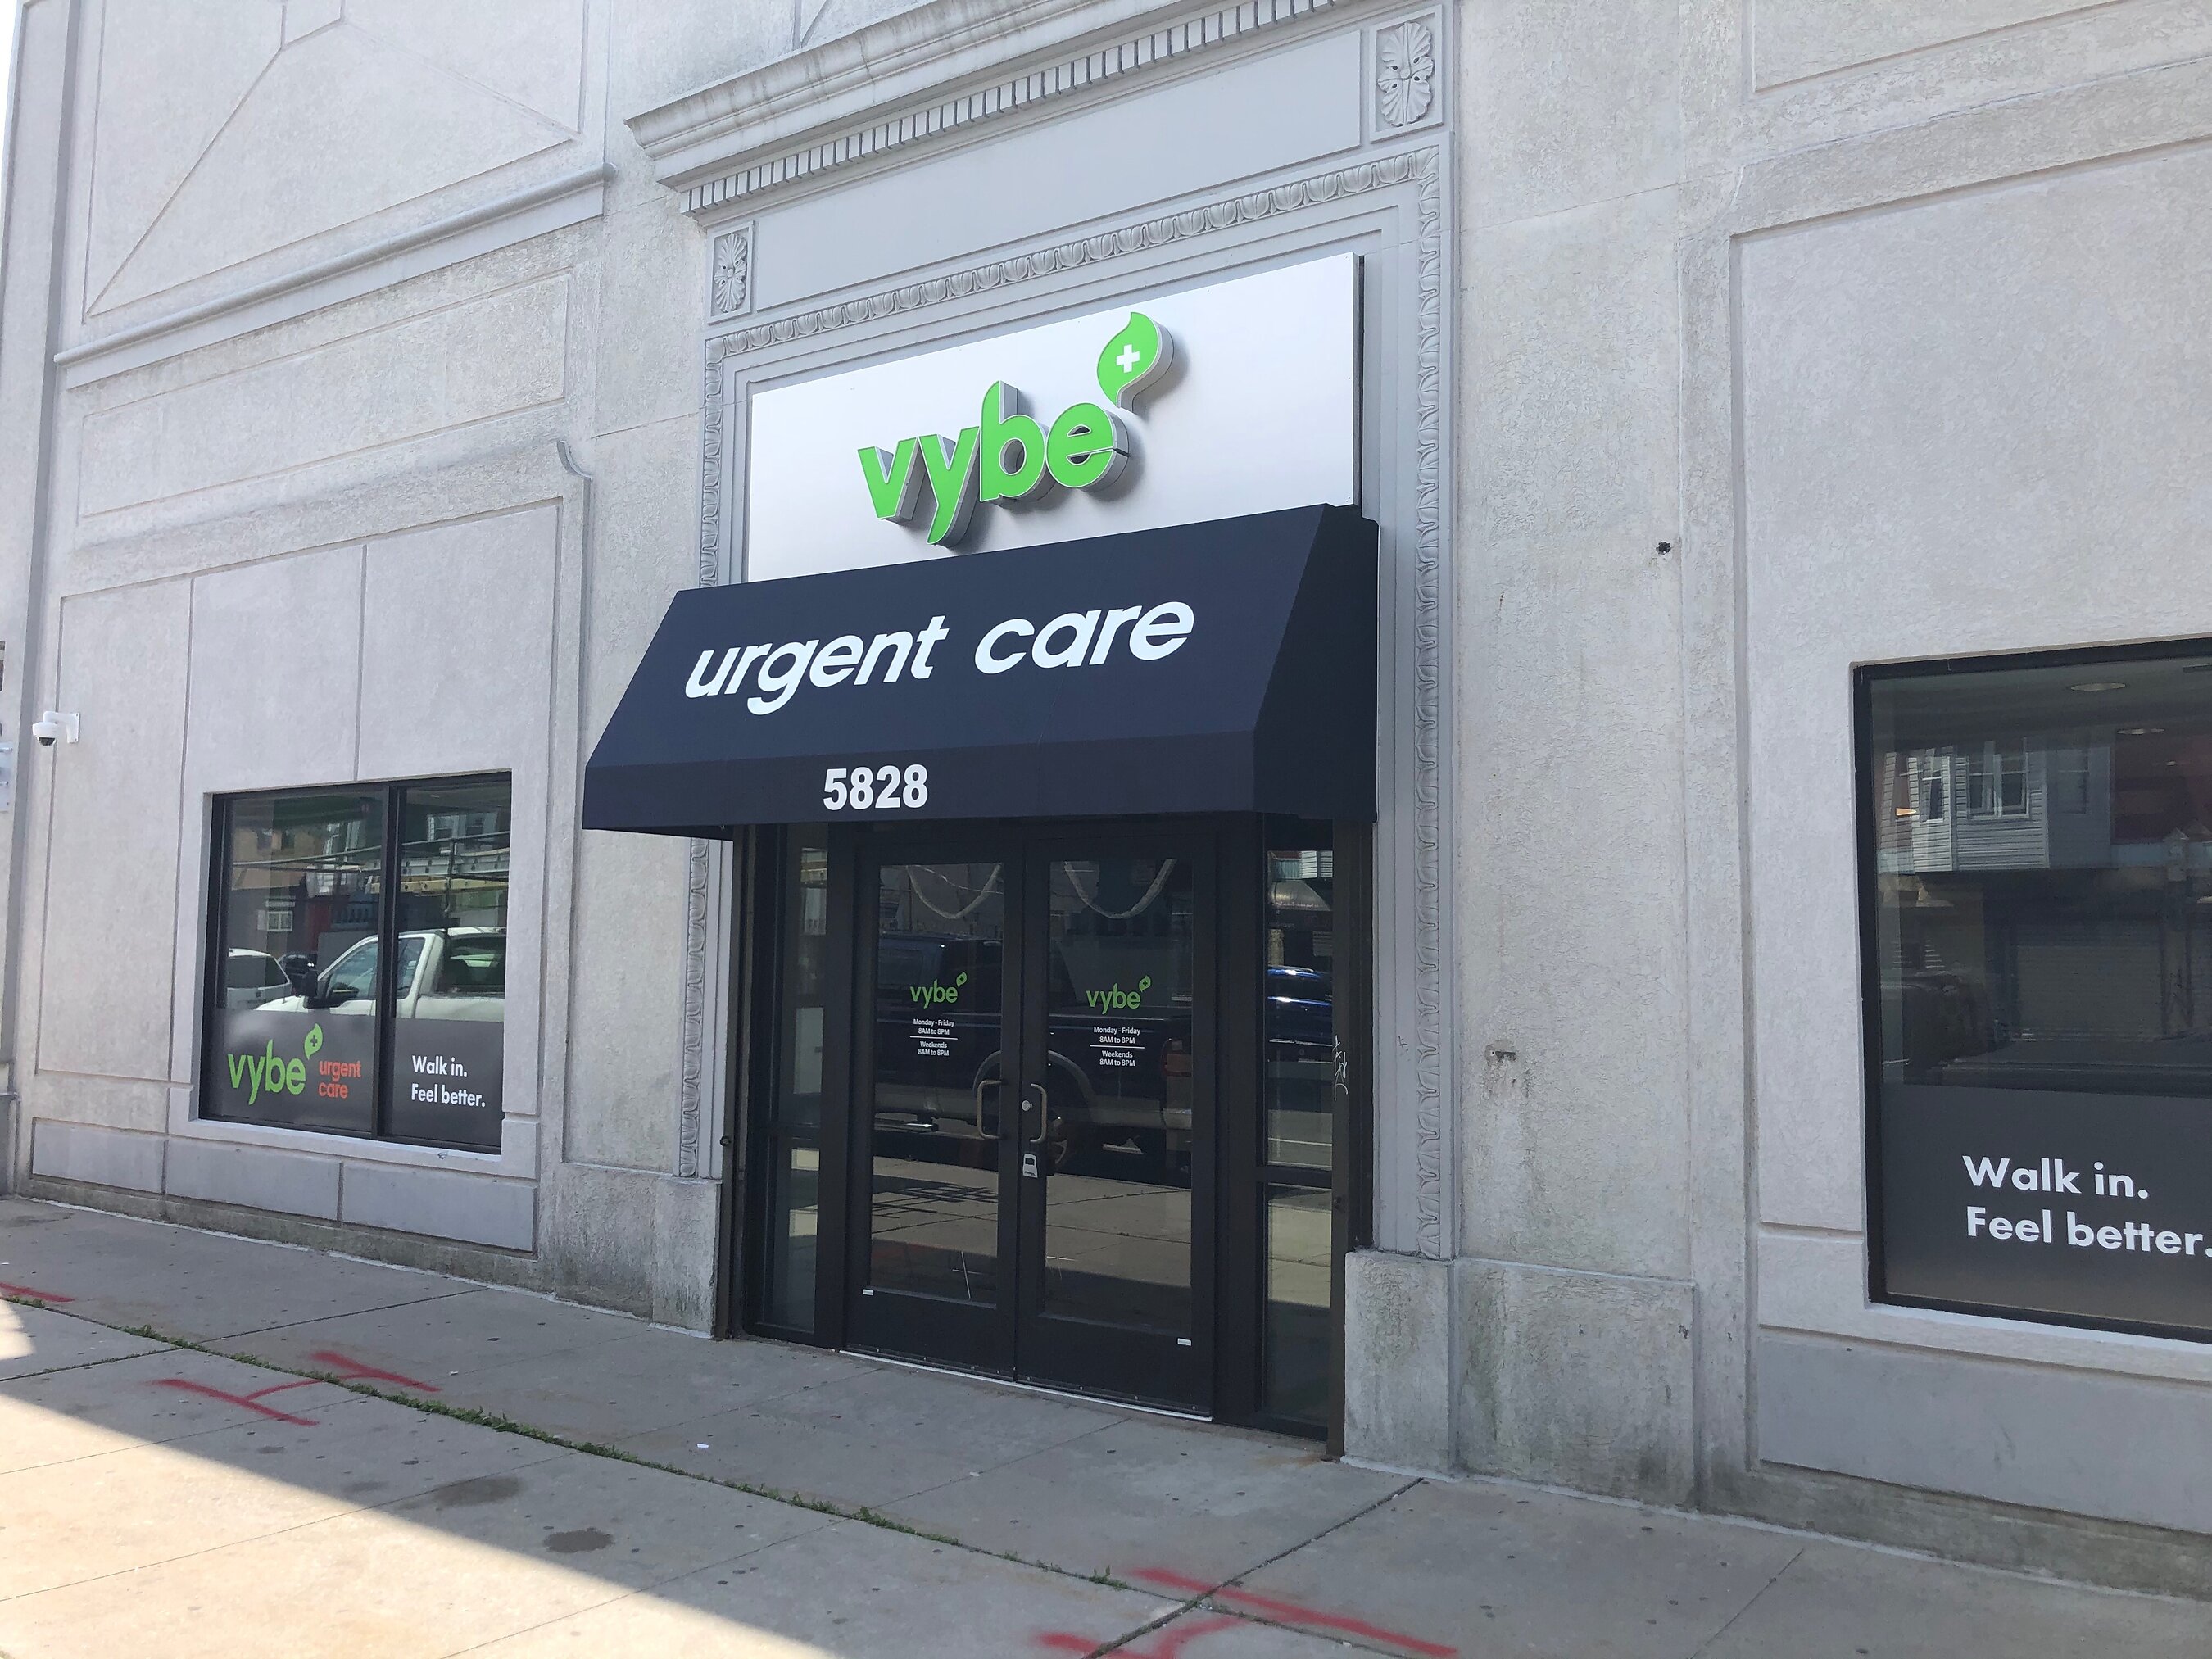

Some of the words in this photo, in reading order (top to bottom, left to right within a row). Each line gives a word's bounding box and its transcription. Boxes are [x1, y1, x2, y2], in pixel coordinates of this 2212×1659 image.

[857, 379, 1117, 545] vybe
[685, 615, 950, 715] urgent
[974, 601, 1195, 674] care
[822, 763, 929, 812] 5828
[909, 979, 959, 1009] vybe
[1086, 982, 1141, 1015] vybe
[913, 1018, 935, 1027] Monday
[937, 1019, 955, 1028] Friday
[1093, 1026, 1117, 1036] Monday
[1122, 1027, 1141, 1036] Friday
[919, 1040, 948, 1049] Weekends
[1099, 1036, 1113, 1044] 8AM
[1121, 1036, 1135, 1045] 8PM
[411, 1054, 448, 1075] Walk
[451, 1056, 468, 1077] in.
[1099, 1058, 1114, 1066] 8AM
[1113, 1058, 1122, 1067] to
[1121, 1058, 1136, 1067] 8PM
[1101, 1050, 1133, 1058] Weekends
[227, 1038, 306, 1106] vybe
[318, 1060, 362, 1082] urgent
[317, 1081, 349, 1099] care
[411, 1082, 438, 1103] Feel
[441, 1083, 486, 1108] better.
[1961, 1154, 2082, 1194] Walk
[2093, 1161, 2149, 1199] in.
[1966, 1205, 2052, 1244] Feel
[2066, 1211, 2212, 1258] better.
